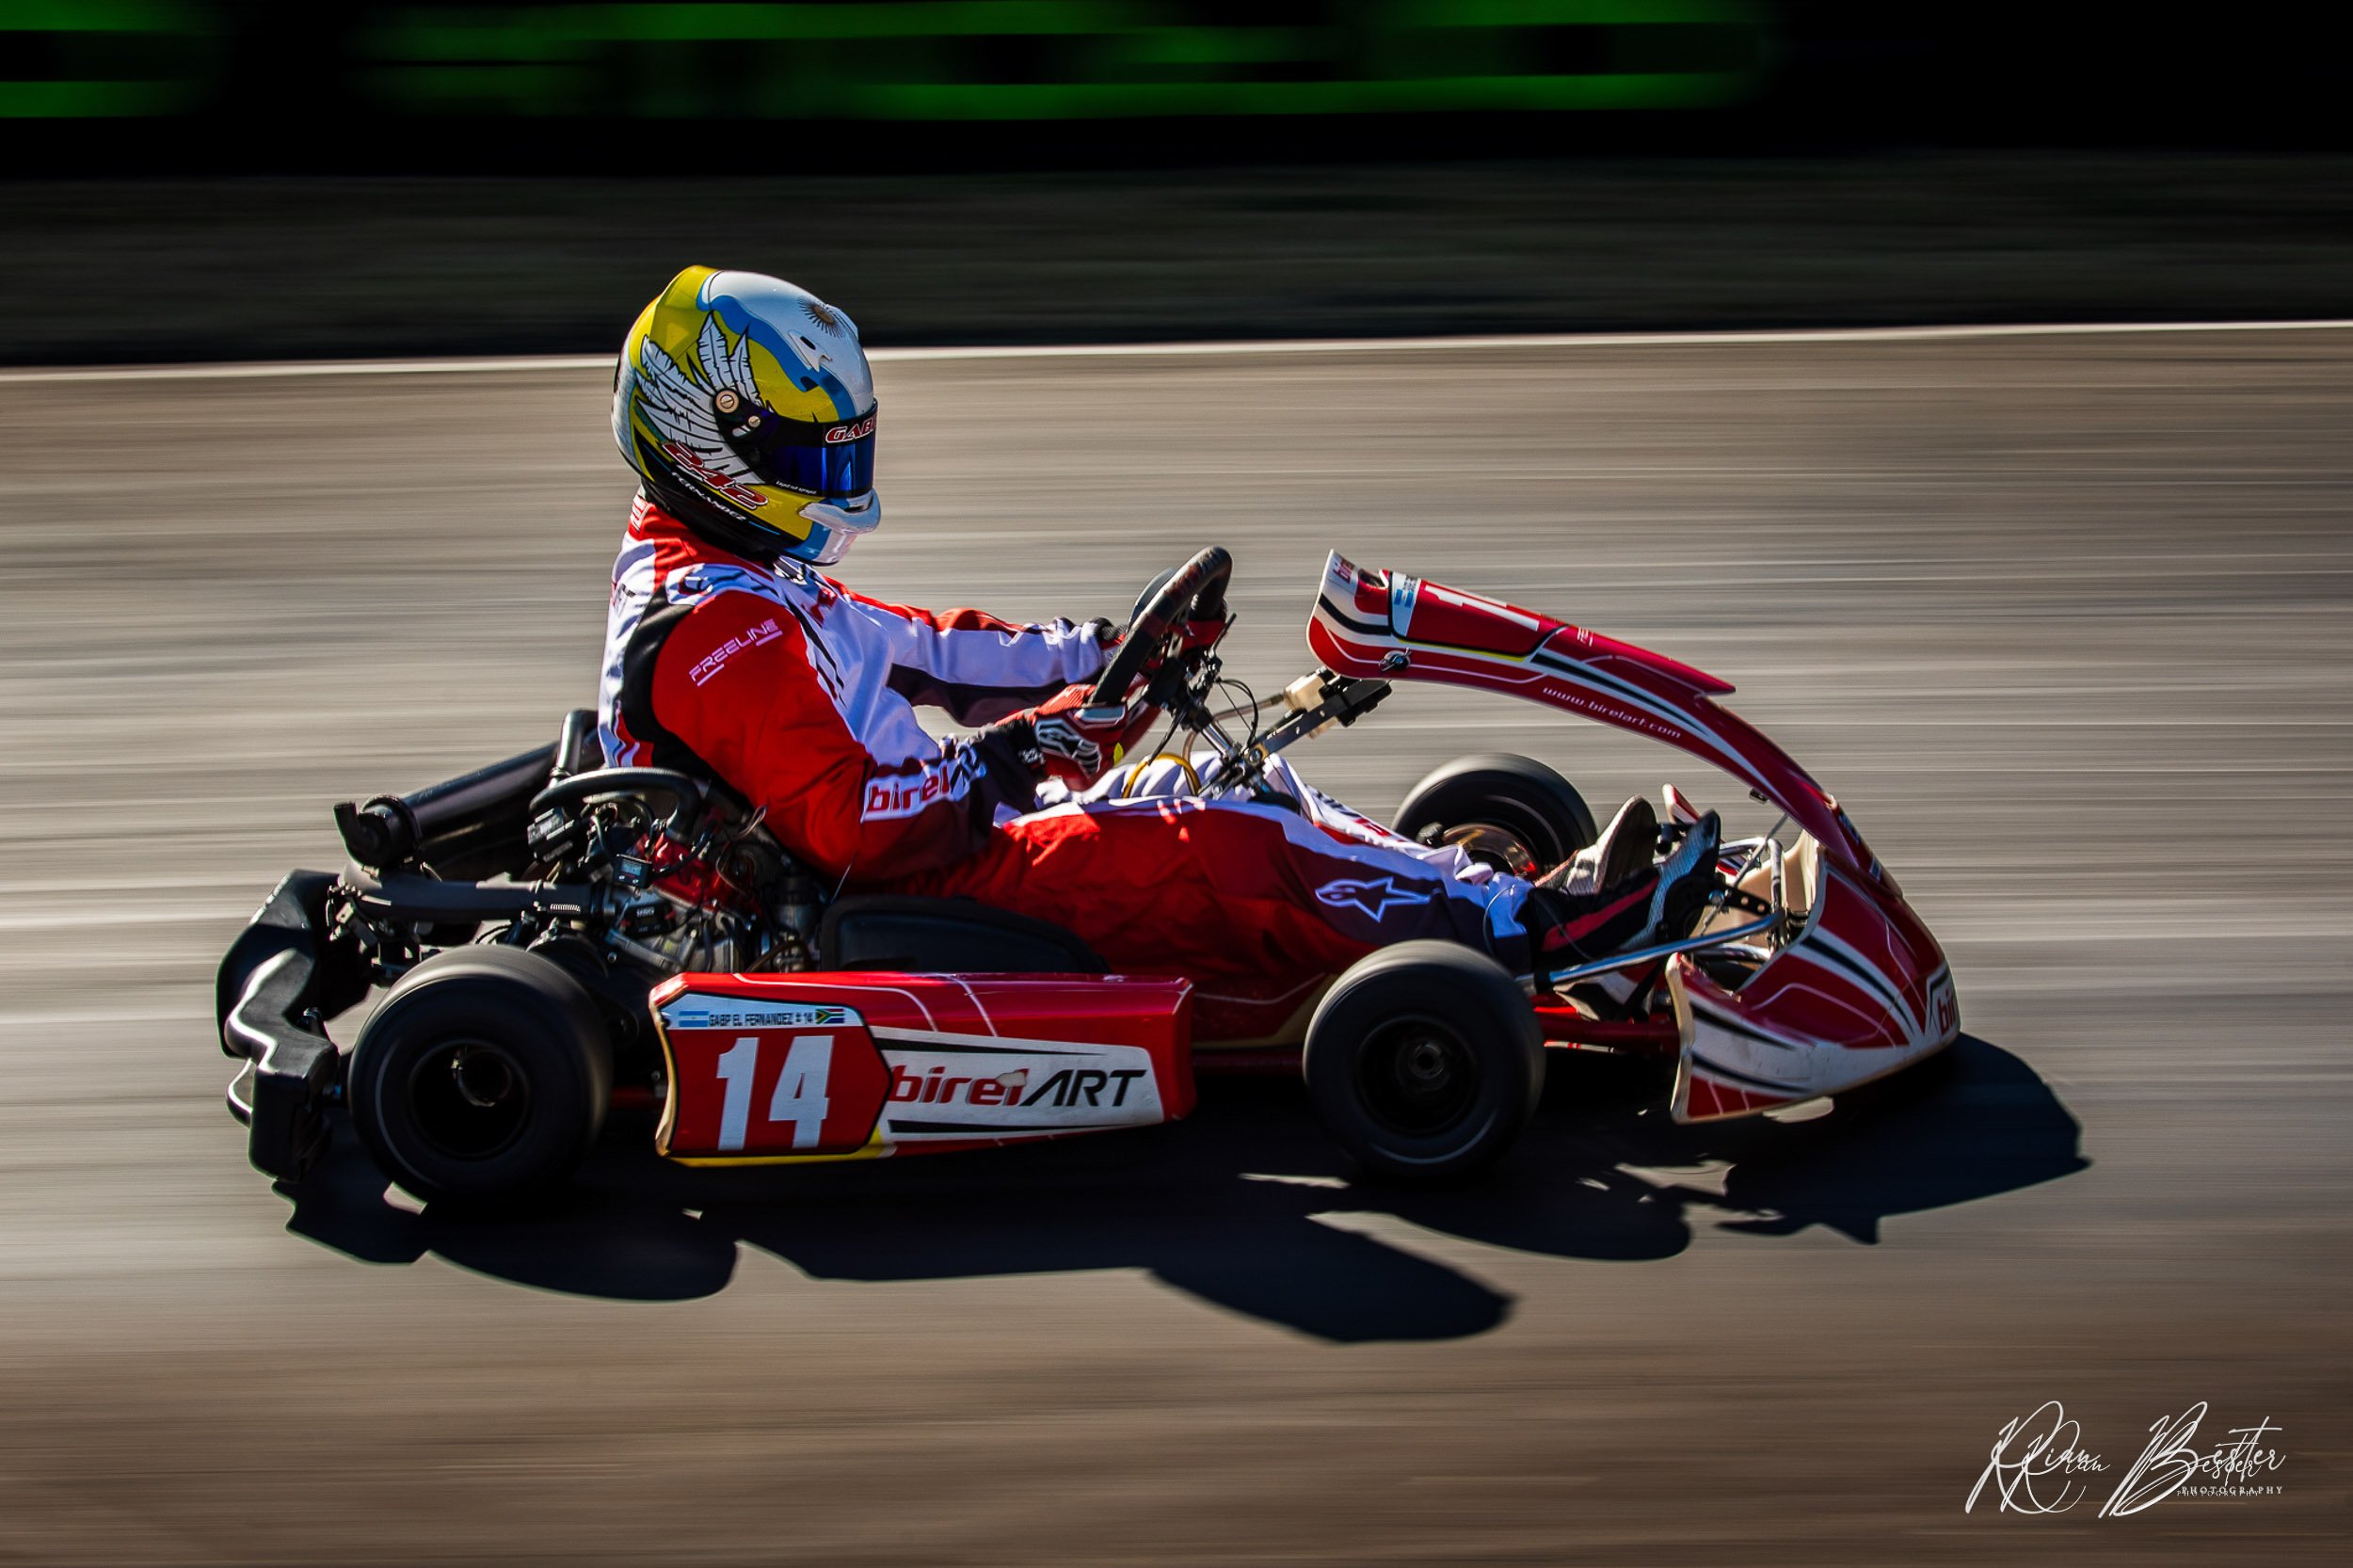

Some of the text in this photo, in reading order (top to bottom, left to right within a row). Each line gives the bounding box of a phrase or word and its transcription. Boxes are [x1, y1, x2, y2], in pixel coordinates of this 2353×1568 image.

[825, 415, 876, 443] GAB
[662, 440, 769, 510] 242
[689, 618, 781, 684] FREELINE
[1543, 686, 1682, 739] www.birelart.com
[744, 1013, 792, 1026] FERNANDEZ
[716, 1035, 834, 1151] 14
